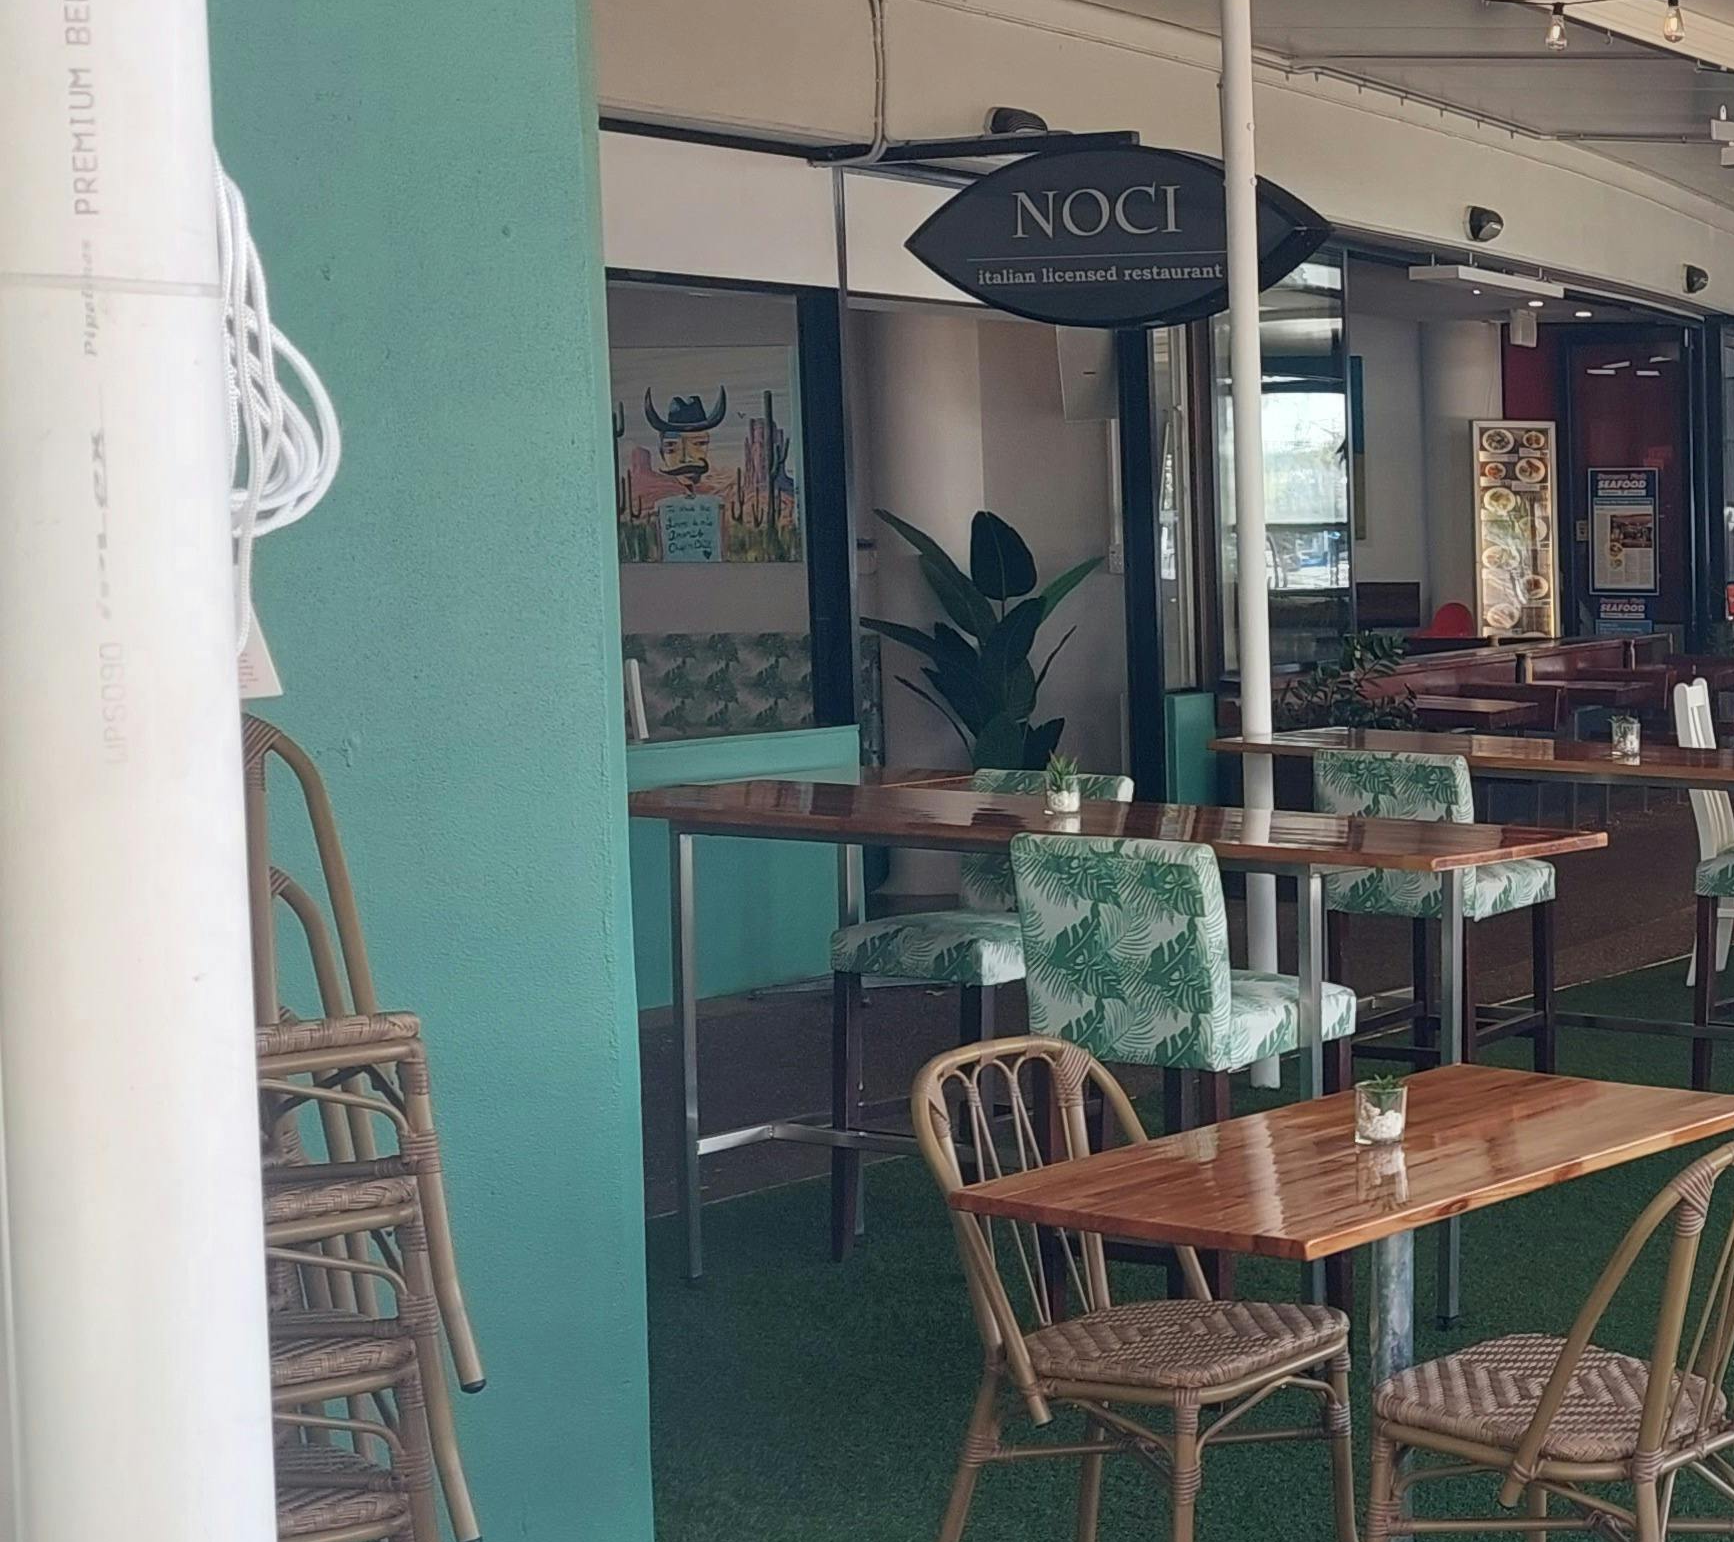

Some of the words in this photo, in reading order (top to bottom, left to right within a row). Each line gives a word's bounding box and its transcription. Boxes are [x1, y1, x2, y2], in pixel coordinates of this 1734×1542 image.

[67, 66, 100, 215] PREMIUM
[1011, 181, 1183, 240] NOCI
[978, 268, 1036, 285] italian
[1042, 265, 1117, 283] licensed
[1123, 263, 1223, 280] restaurant
